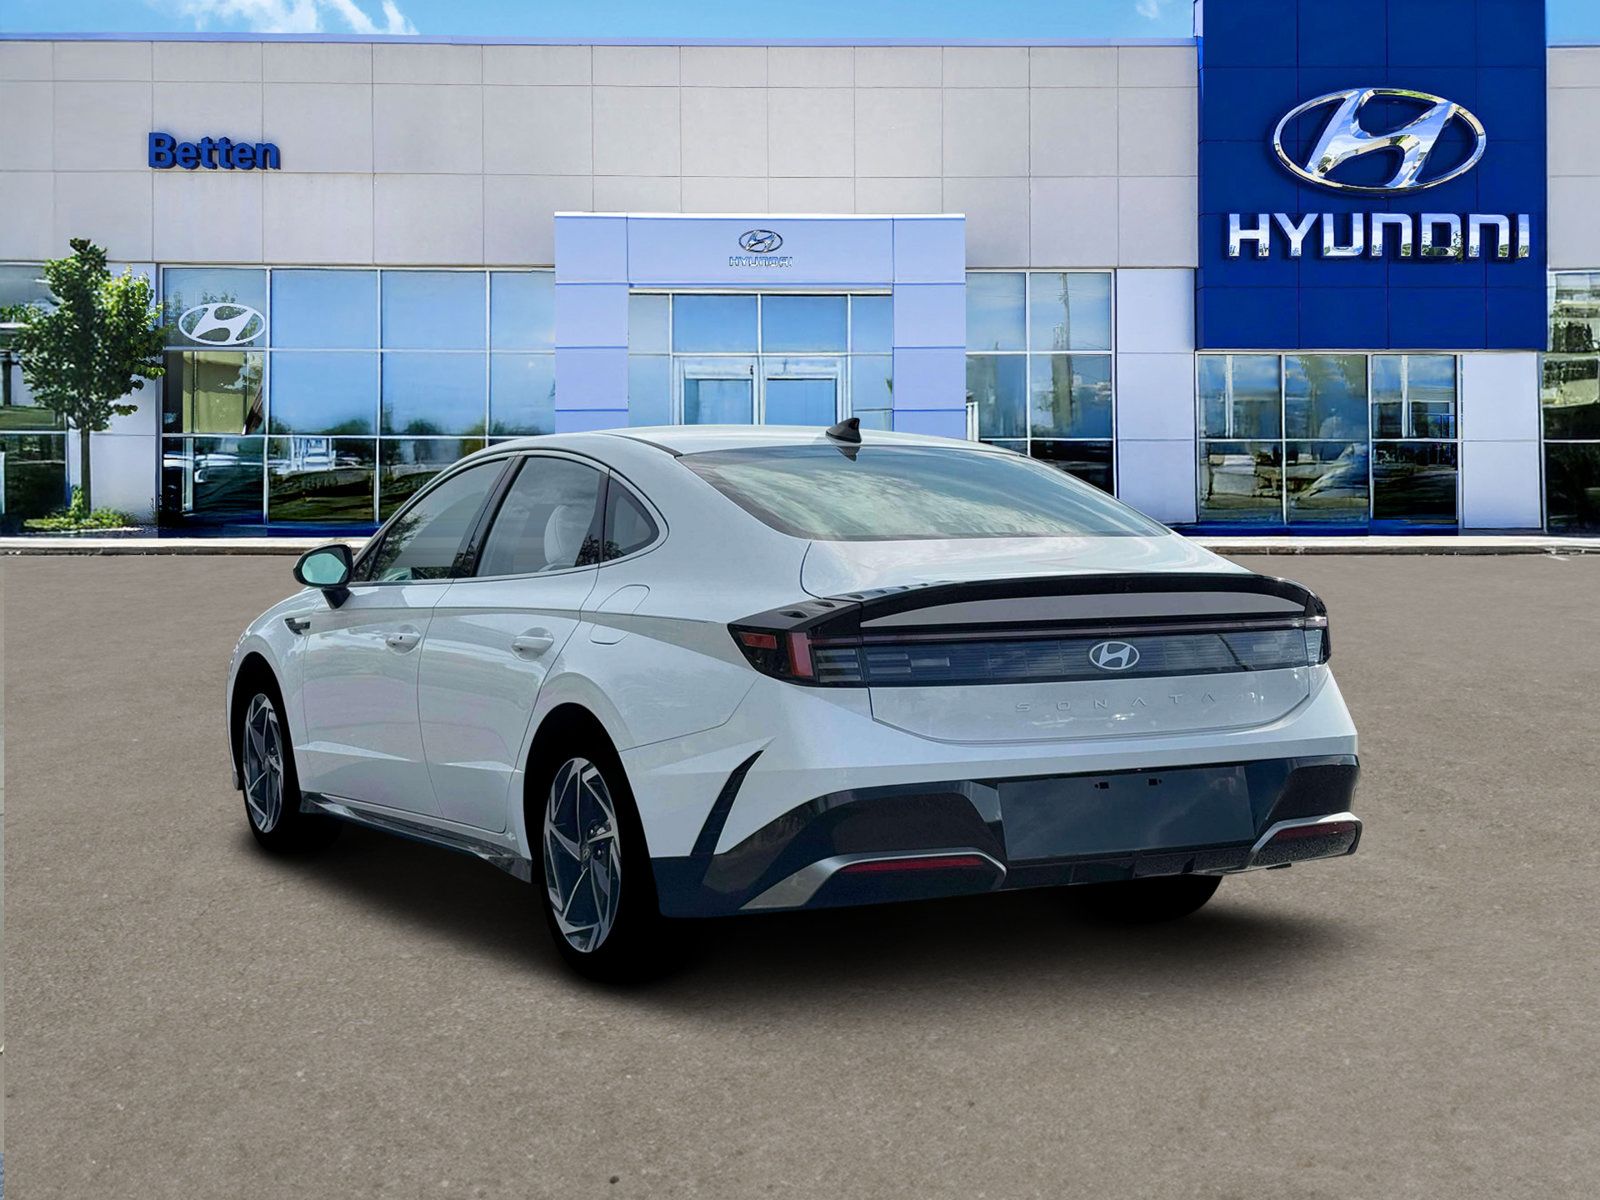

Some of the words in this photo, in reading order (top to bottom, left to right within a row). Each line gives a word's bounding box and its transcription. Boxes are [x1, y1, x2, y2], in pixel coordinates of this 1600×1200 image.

[148, 132, 281, 170] Betten
[1228, 212, 1531, 260] HYUNDAI
[728, 256, 794, 267] HYUNDAI
[1015, 692, 1216, 712] SONATA
